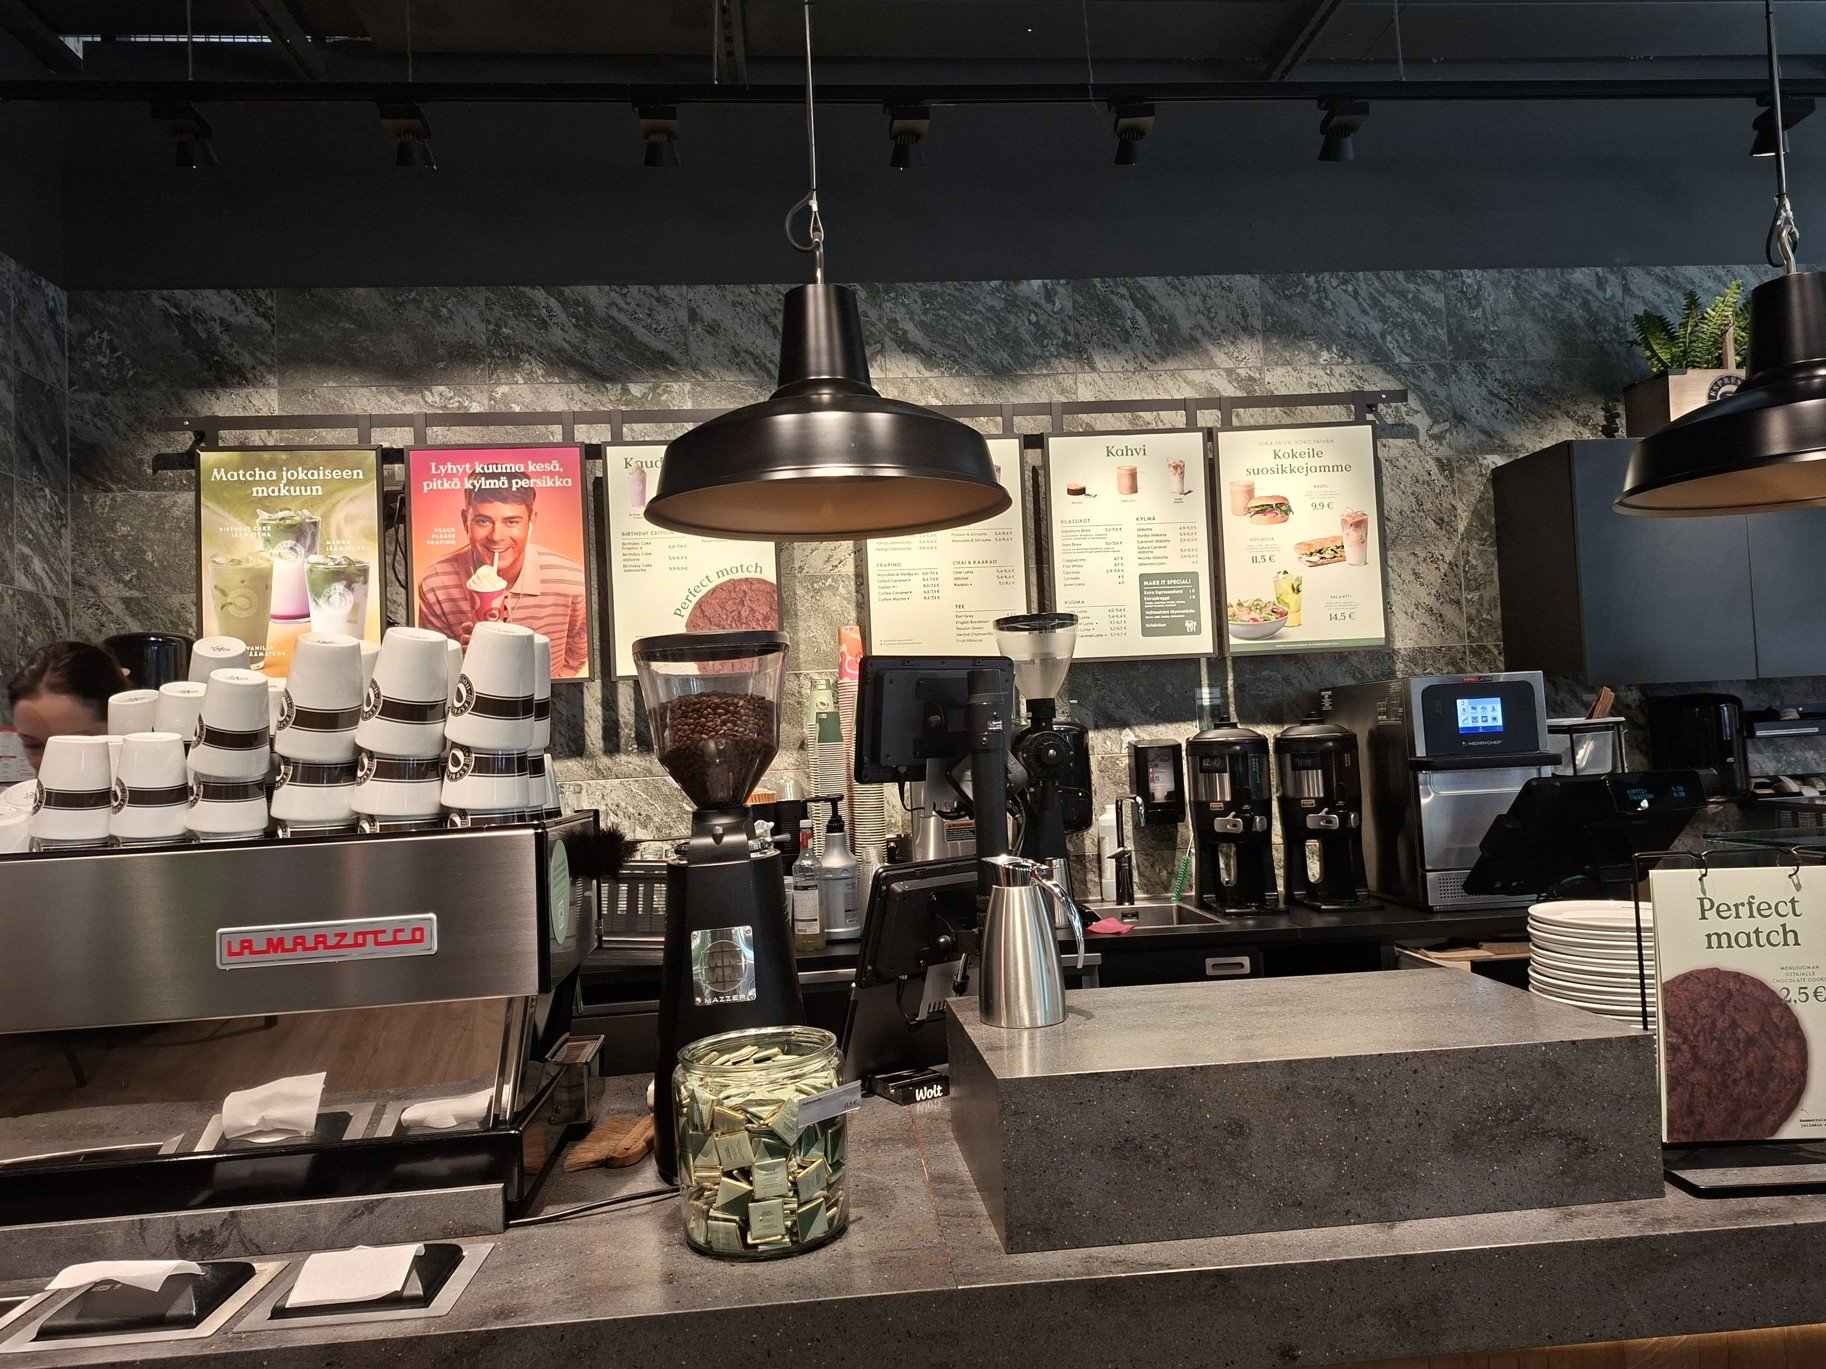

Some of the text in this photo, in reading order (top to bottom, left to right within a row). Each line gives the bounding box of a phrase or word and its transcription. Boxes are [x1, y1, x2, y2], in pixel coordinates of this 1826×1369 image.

[1105, 444, 1147, 457] Kahvi
[1273, 448, 1324, 460] Kokeile
[210, 467, 364, 483] Matcha jokaiseen
[430, 460, 563, 476] Lyhyt kuuma kesä,
[1245, 462, 1353, 476] suosikkejamme
[252, 484, 323, 497] makuun
[423, 475, 572, 493] pitkä kylmä persikka
[1310, 501, 1334, 511] 9,9 €
[1251, 554, 1276, 564] 11,5 €
[673, 562, 763, 619] Perfect match
[1329, 611, 1356, 621] 14,5 €
[1696, 895, 1803, 921] Perfect
[227, 926, 425, 957] LA MARZOCCO
[1704, 923, 1802, 950] match
[704, 994, 746, 1005] MAZZER
[1779, 985, 1826, 1005] 2,5 €
[915, 1084, 943, 1102] Wolt
